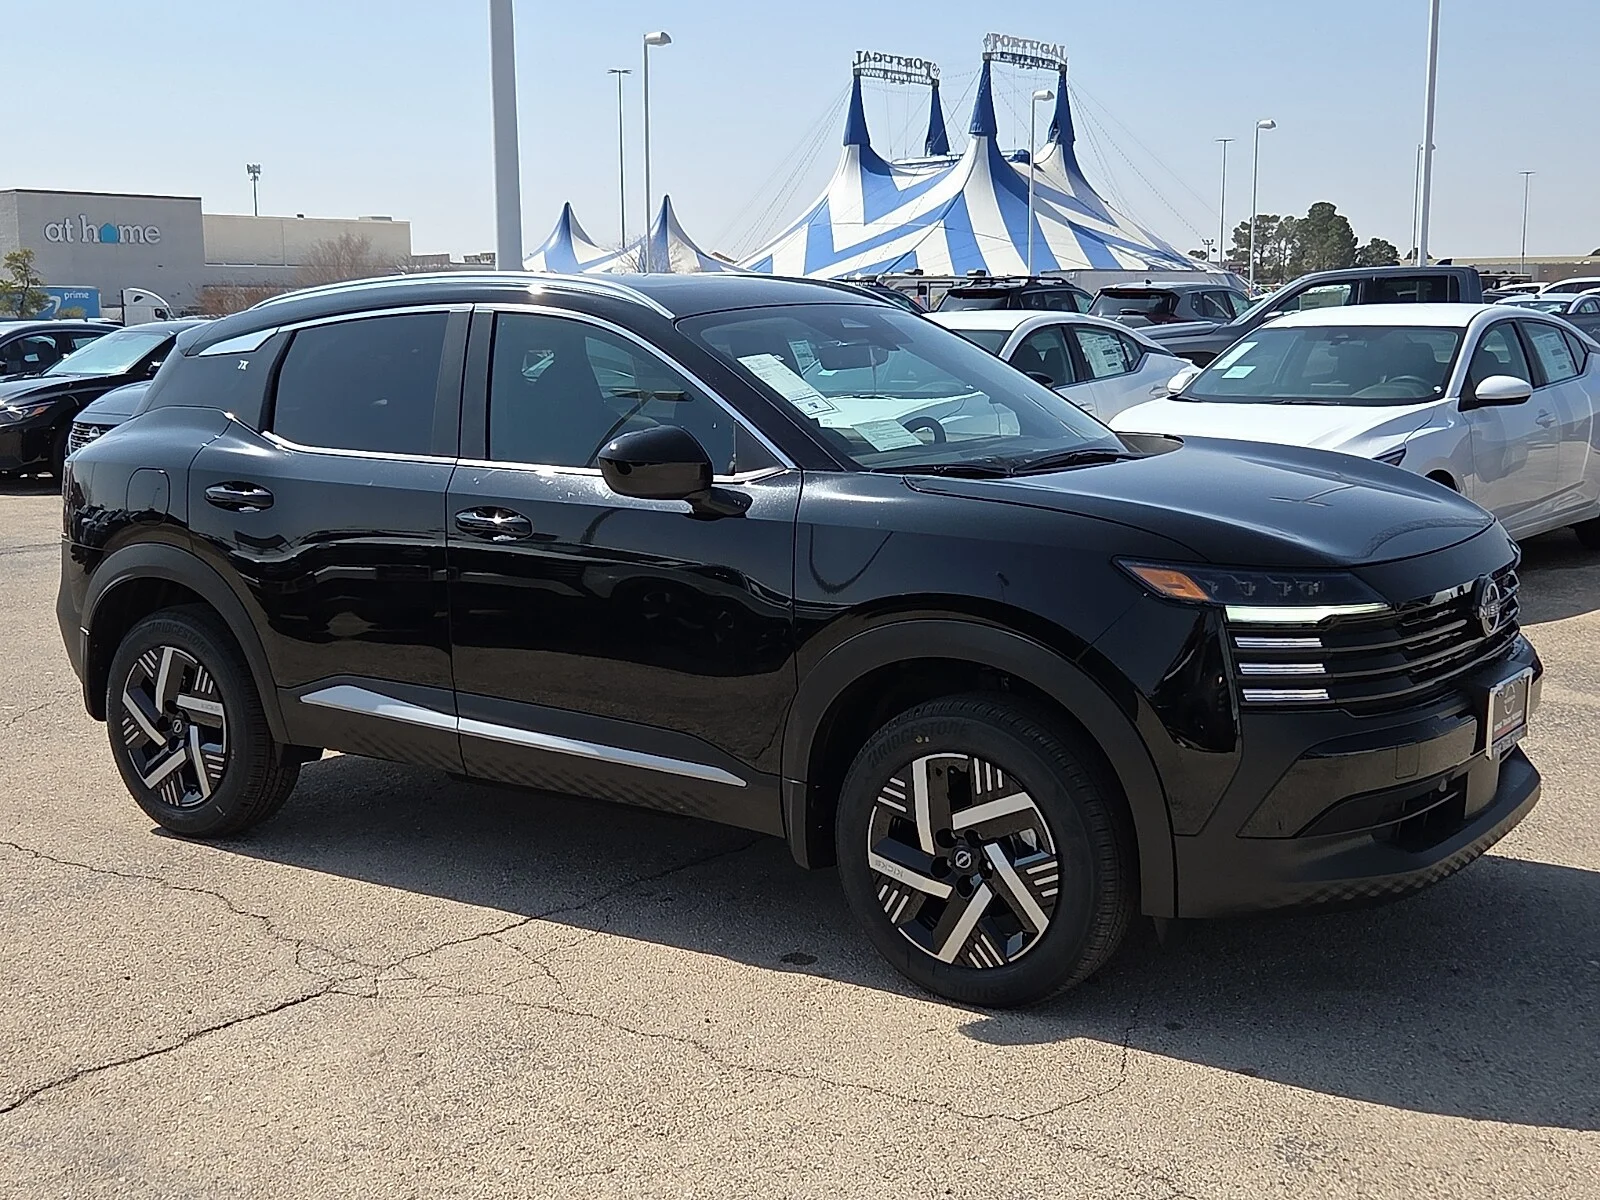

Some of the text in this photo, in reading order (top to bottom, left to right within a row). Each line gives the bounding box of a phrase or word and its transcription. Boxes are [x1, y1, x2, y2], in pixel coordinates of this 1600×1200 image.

[991, 33, 1068, 64] PORTUGAL
[44, 213, 161, 244] at home
[63, 290, 90, 301] prime
[875, 859, 903, 878] KICKS
